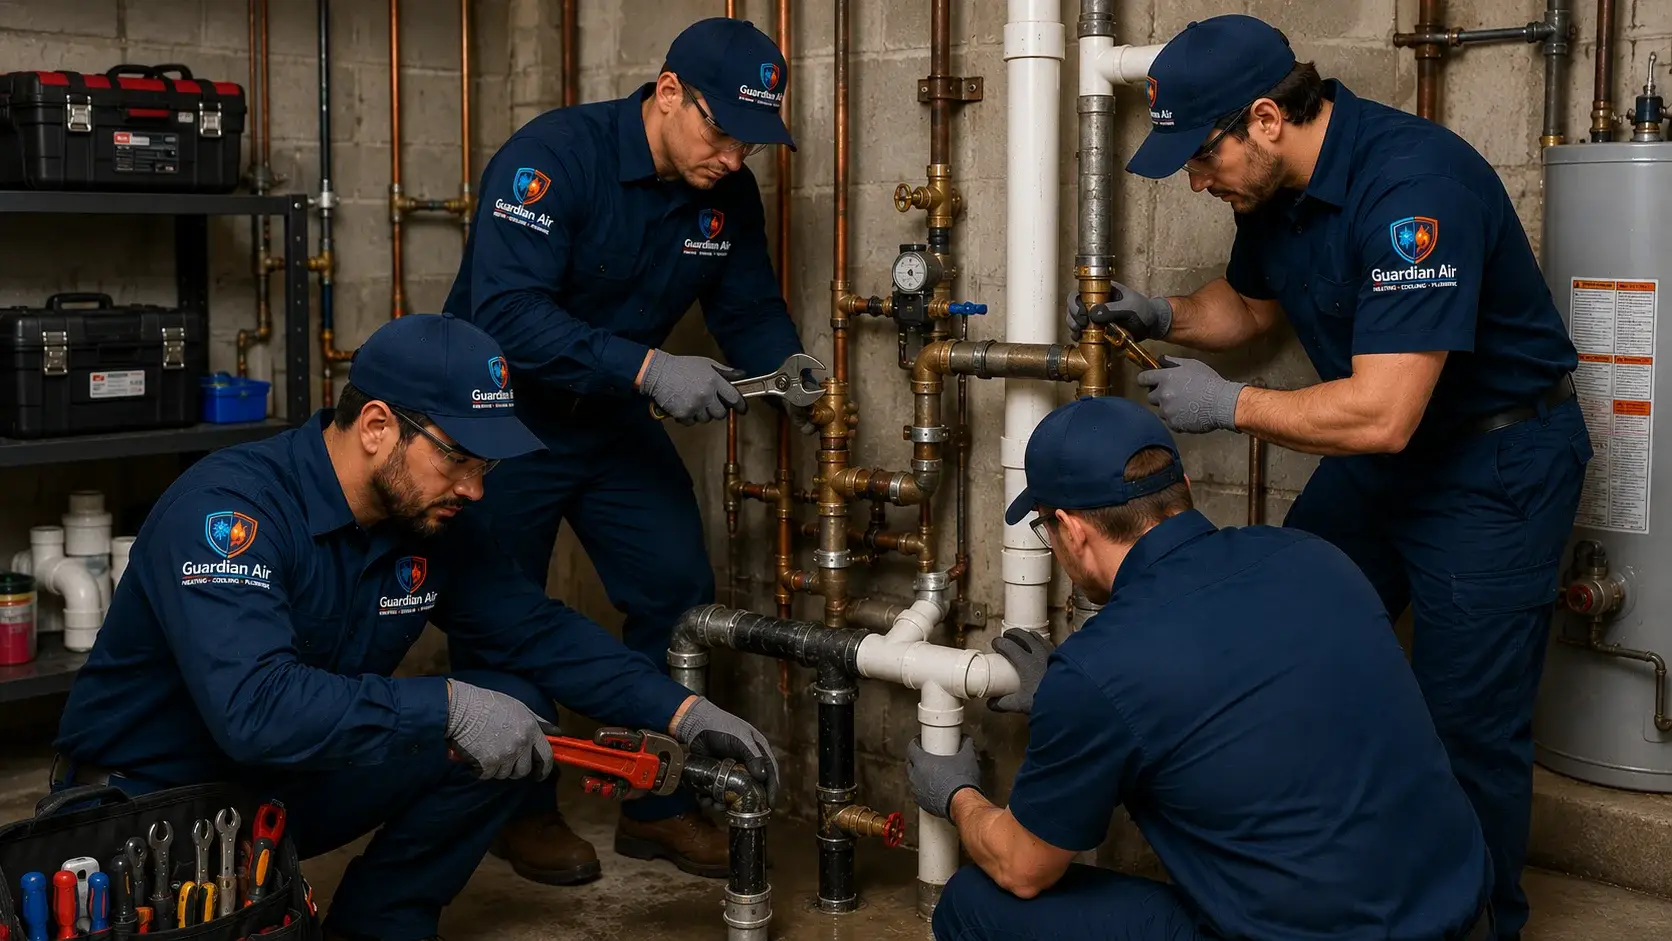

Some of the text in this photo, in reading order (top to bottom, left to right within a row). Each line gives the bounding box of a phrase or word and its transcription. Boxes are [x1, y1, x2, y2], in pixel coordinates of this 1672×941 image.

[1161, 109, 1173, 119] Air
[495, 198, 535, 221] Guardian
[536, 213, 554, 228] Air
[684, 238, 731, 250] Guardian Air
[1371, 264, 1457, 282] Guardian Air
[182, 559, 272, 580] Guardian Air
[379, 591, 438, 608] Guardian Air
